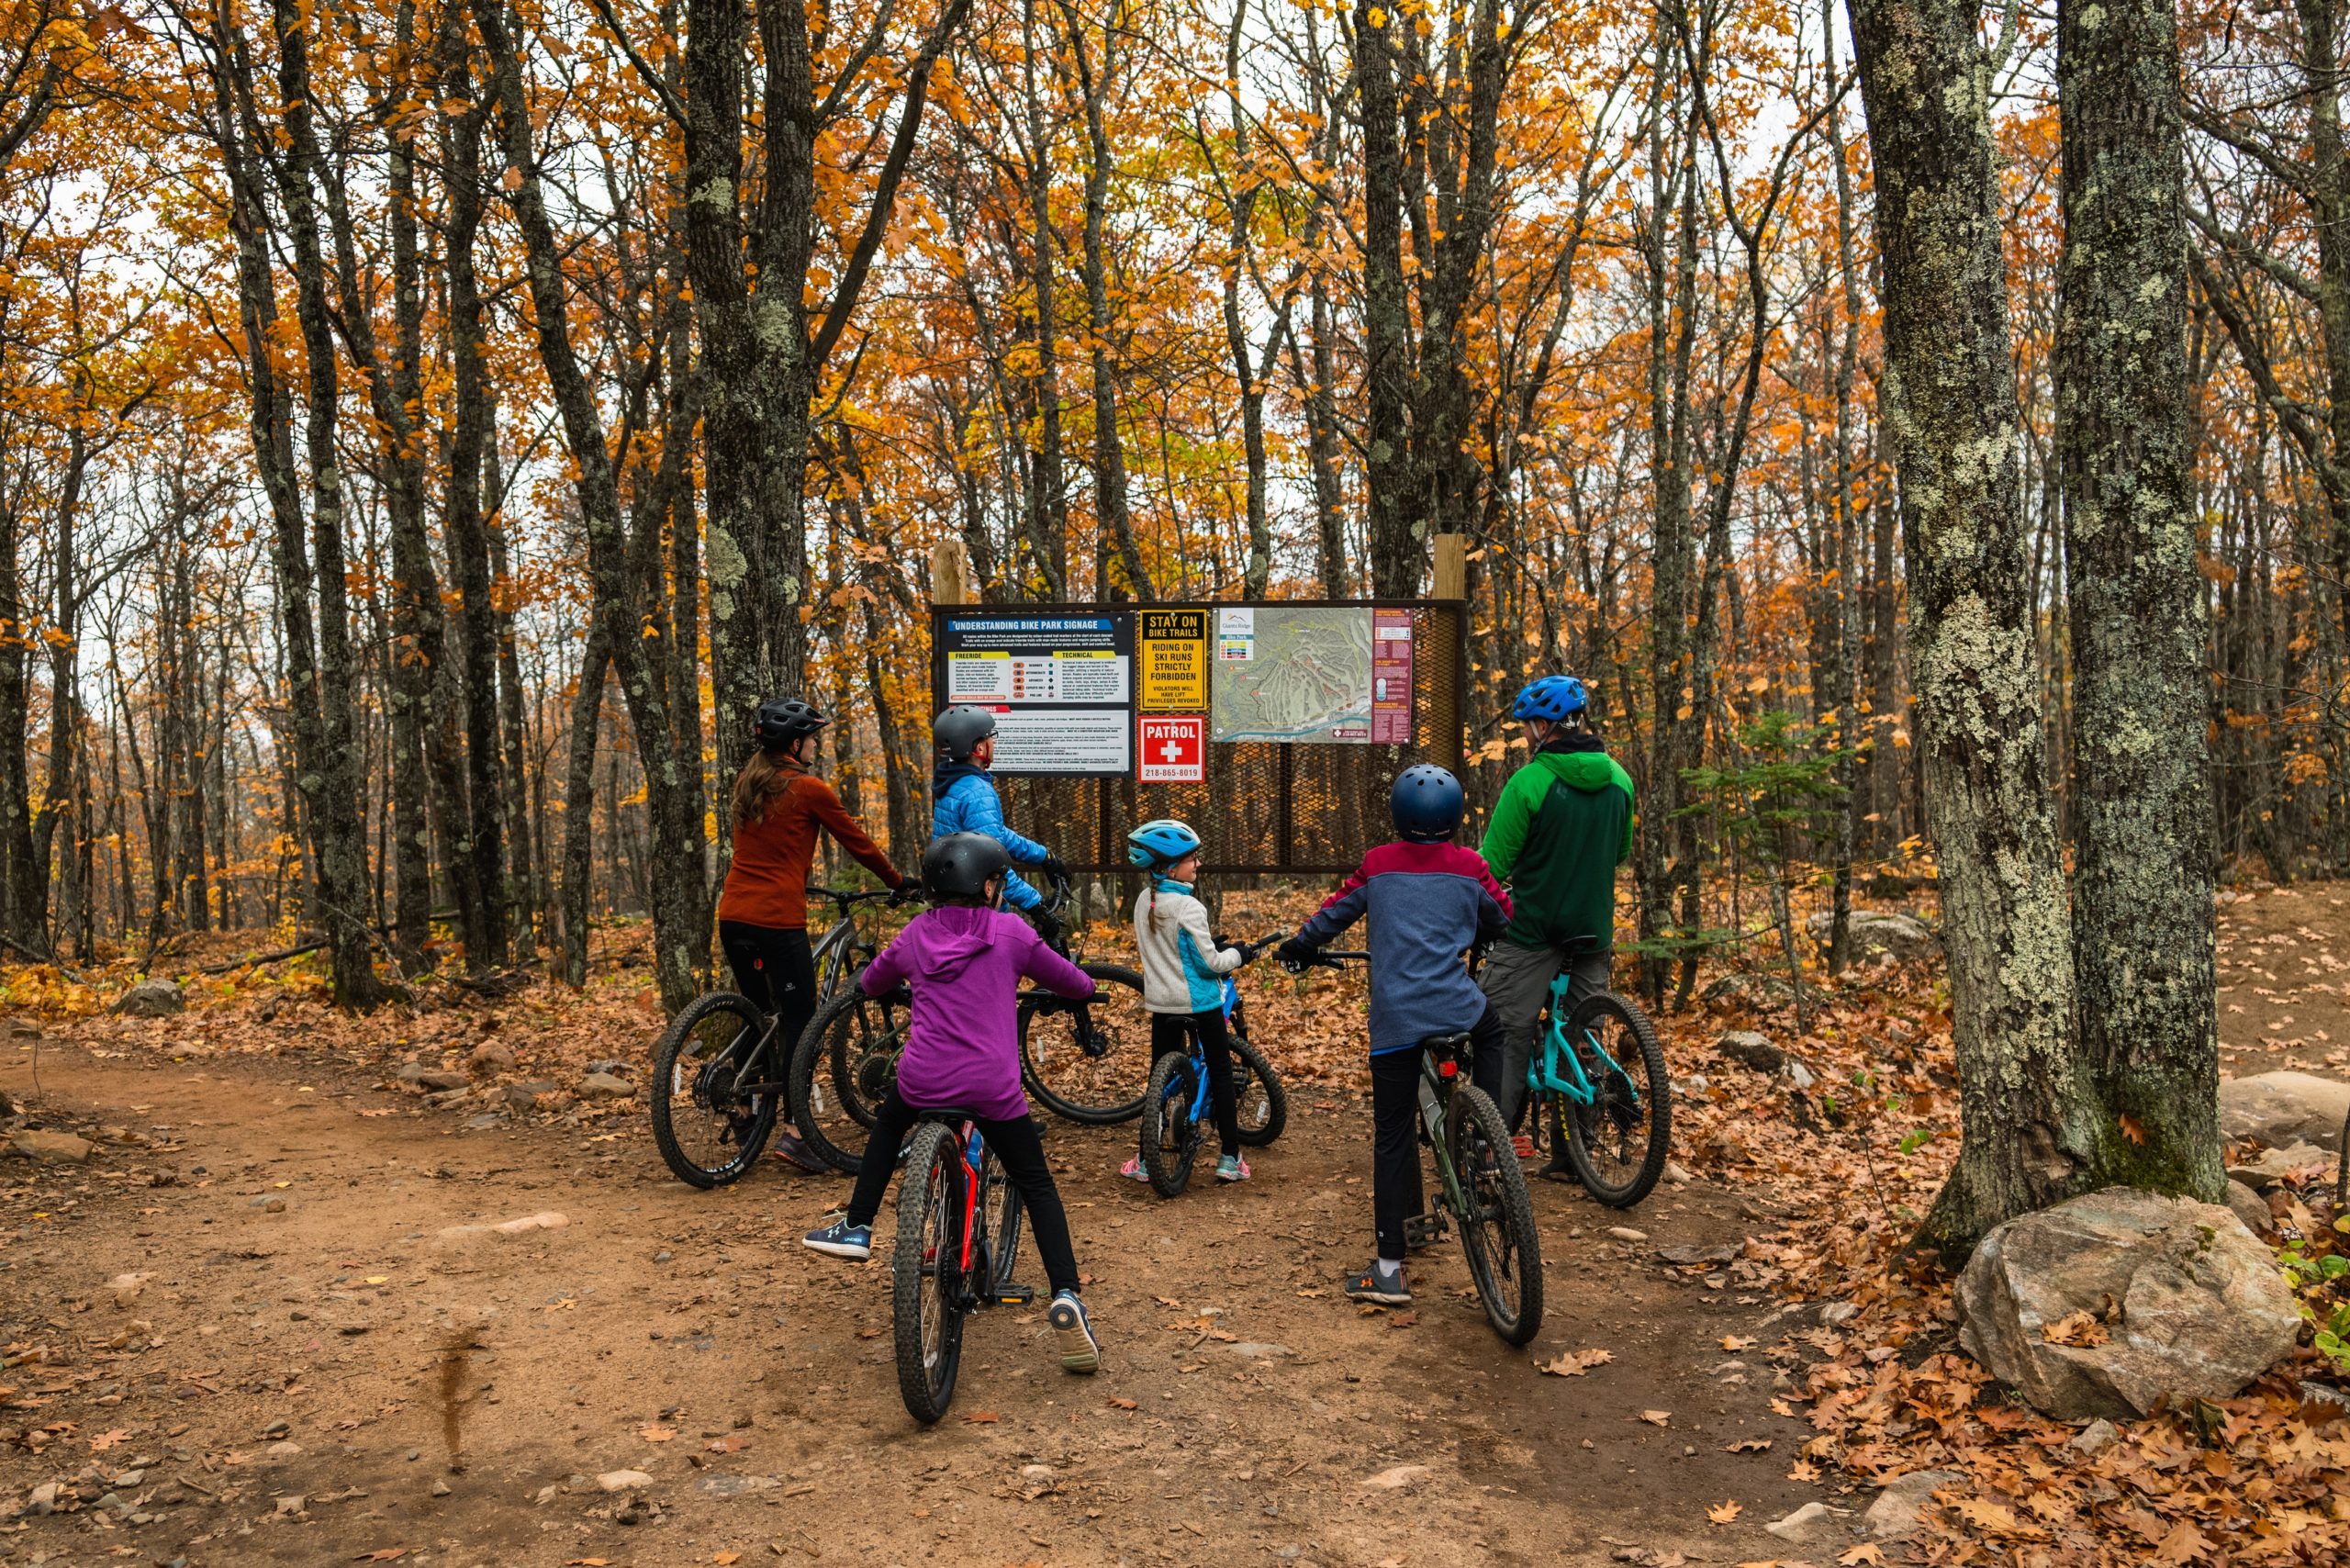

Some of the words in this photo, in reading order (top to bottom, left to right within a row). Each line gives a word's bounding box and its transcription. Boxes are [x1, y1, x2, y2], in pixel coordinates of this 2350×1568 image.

[955, 621, 1019, 630] UNDERSTANDING
[1021, 621, 1039, 629] BIKE
[1041, 621, 1062, 629] PARK
[1064, 621, 1098, 629] SIGNAGE
[1150, 616, 1177, 627] STAY
[1182, 616, 1197, 627] ON
[1170, 629, 1198, 637] TRAILS
[1147, 726, 1196, 739] PATROL
